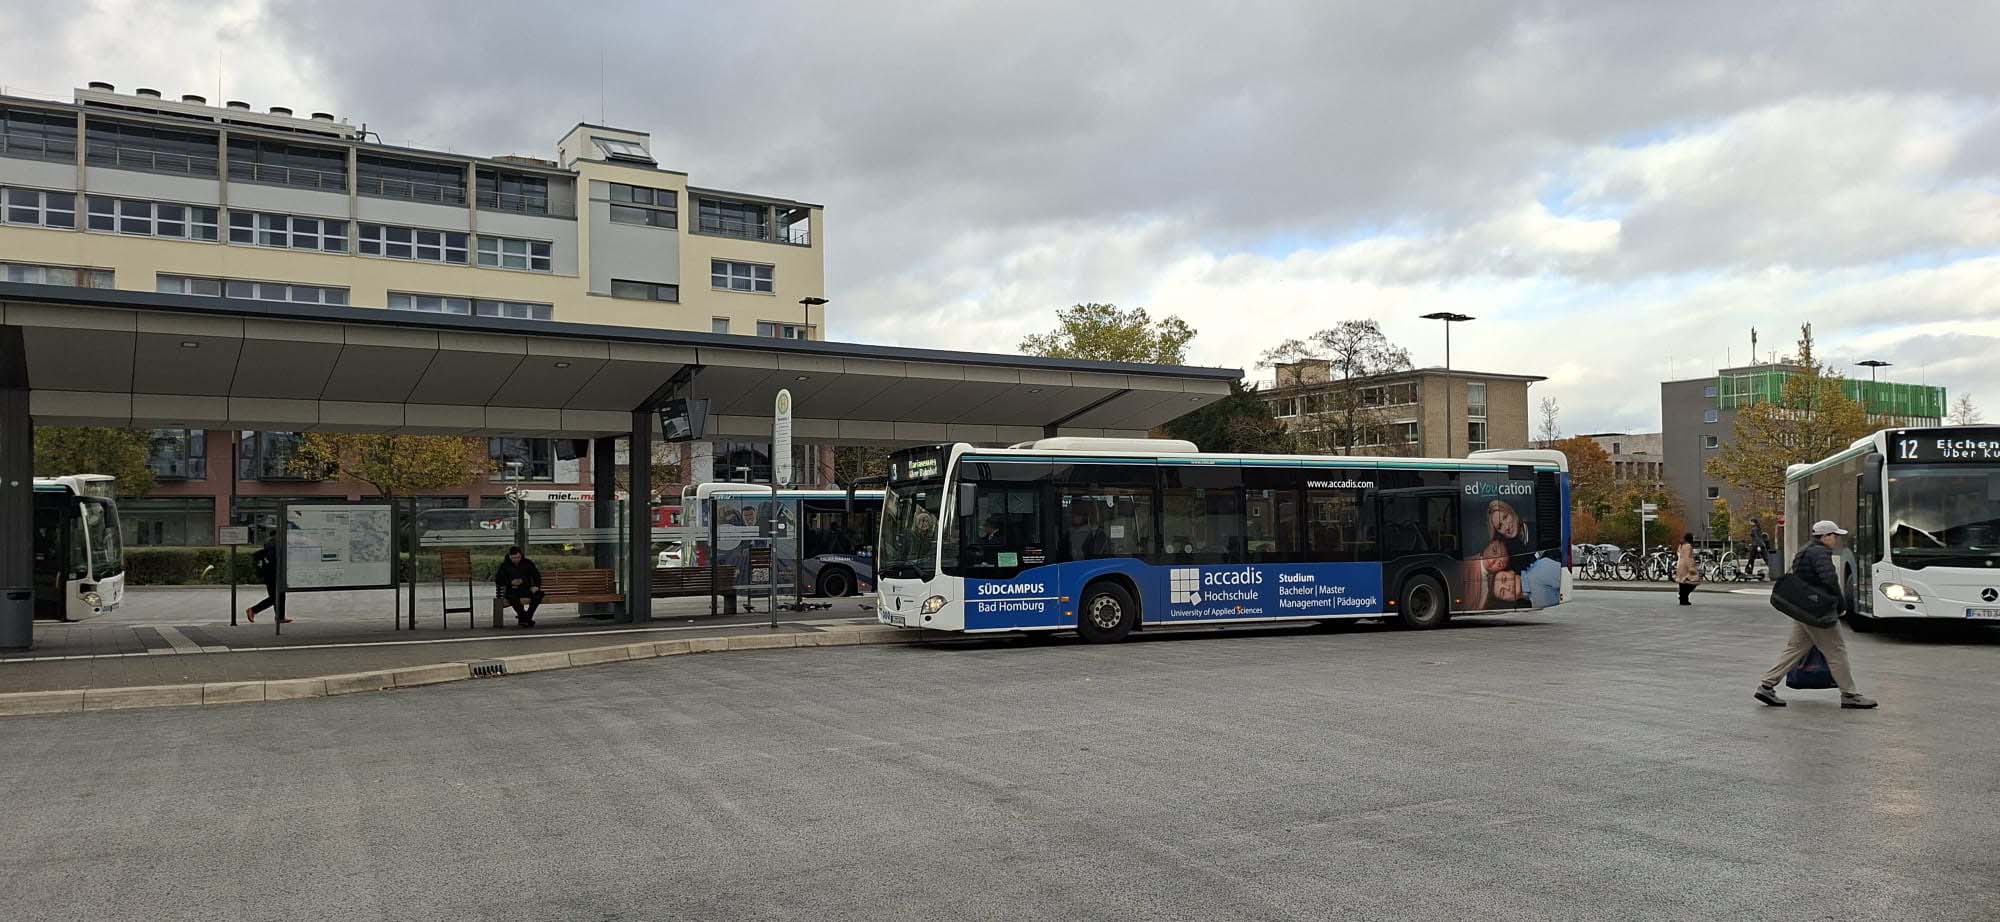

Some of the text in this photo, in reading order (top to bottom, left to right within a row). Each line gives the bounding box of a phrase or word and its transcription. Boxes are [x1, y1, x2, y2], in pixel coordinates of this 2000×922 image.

[1899, 440, 1918, 458] 12
[1307, 479, 1374, 489] www.accadis.com
[1464, 480, 1532, 496] edYoucation
[1204, 566, 1263, 585] accadis
[1279, 572, 1314, 583] Studium
[978, 582, 1044, 595] SÜDCAMPUS
[1280, 585, 1314, 596] Bachelor
[1319, 585, 1346, 594] Master
[1204, 589, 1258, 601] Hochschule
[978, 600, 1044, 612] Bad Homburg
[1280, 598, 1331, 610] Management
[1337, 596, 1376, 608] Pädagogik
[1170, 608, 1202, 617] University
[1211, 608, 1236, 616] Applied
[1236, 606, 1262, 614] Sciences
